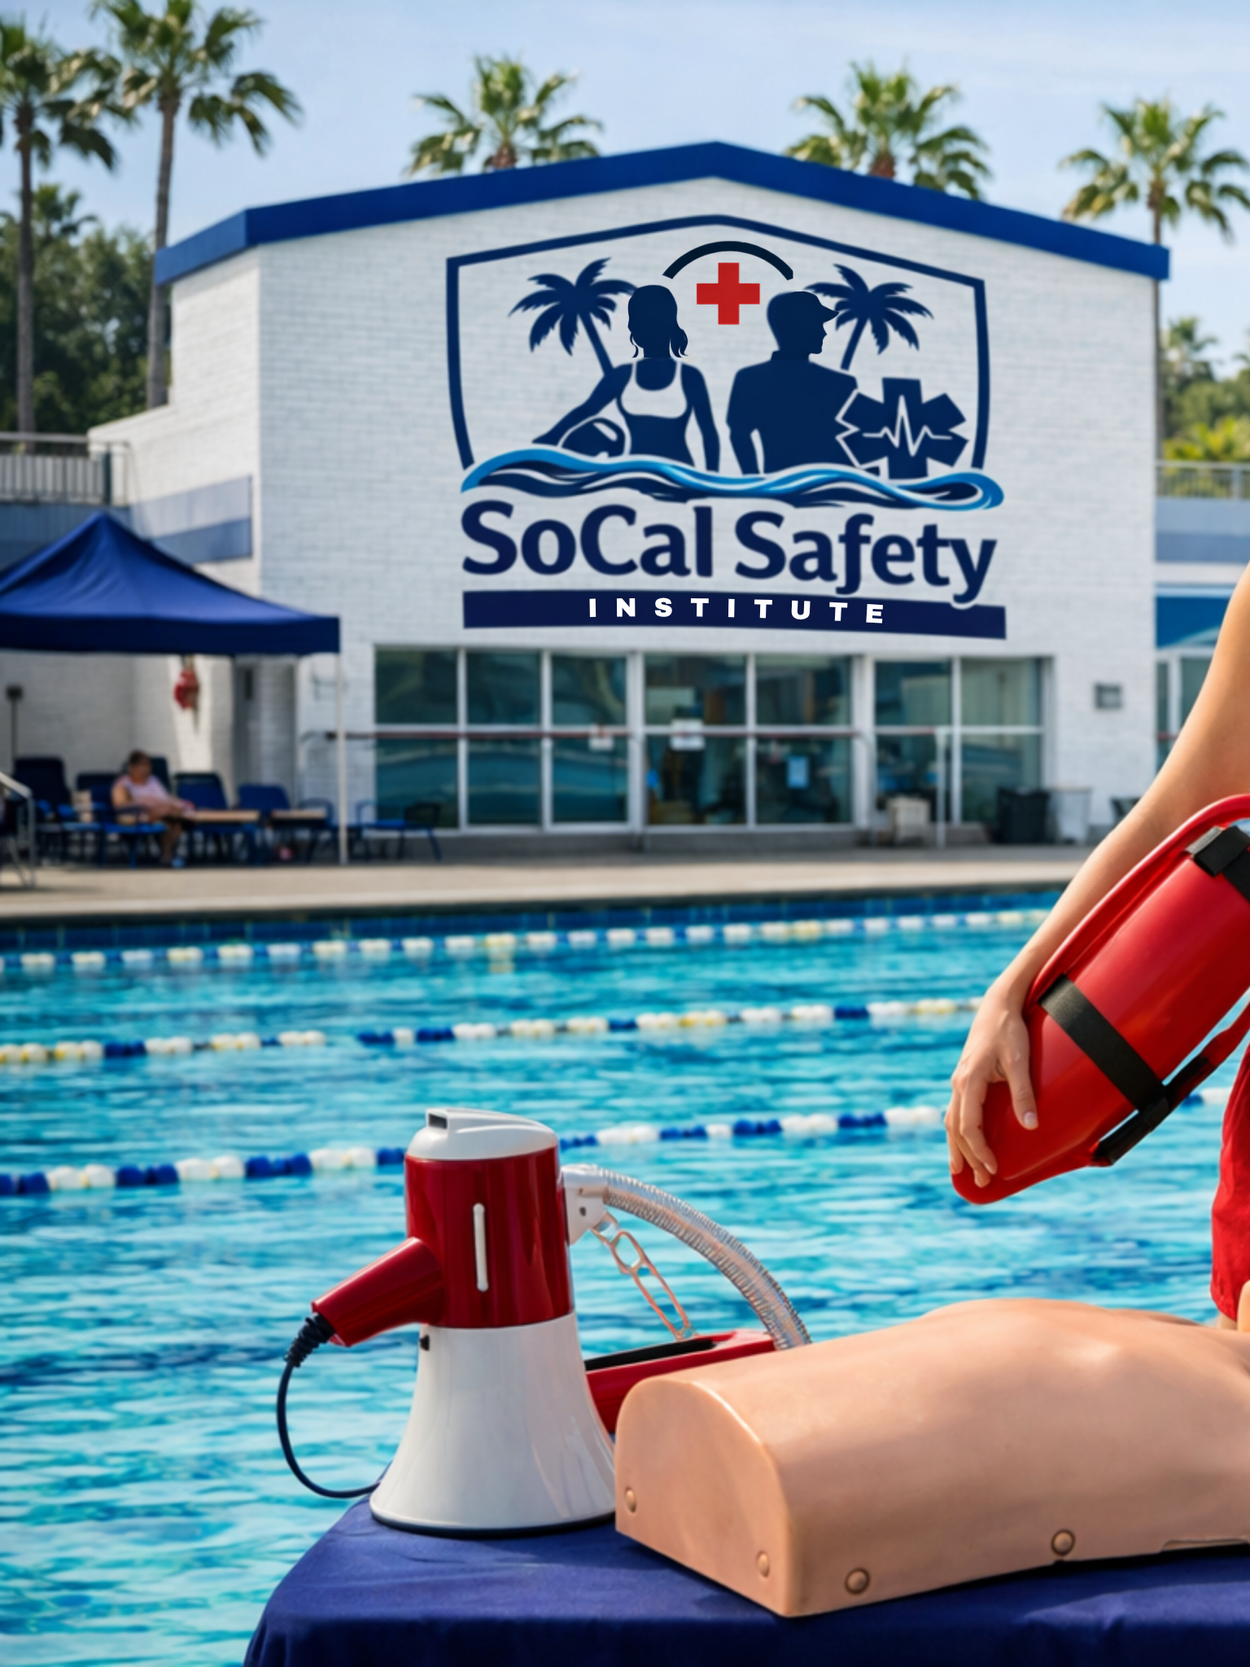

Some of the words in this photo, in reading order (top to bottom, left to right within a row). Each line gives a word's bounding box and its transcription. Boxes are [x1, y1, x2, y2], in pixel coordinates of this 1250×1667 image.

[461, 499, 713, 578] SoCal
[735, 511, 997, 604] Safety
[588, 597, 884, 623] INSTITUTE
